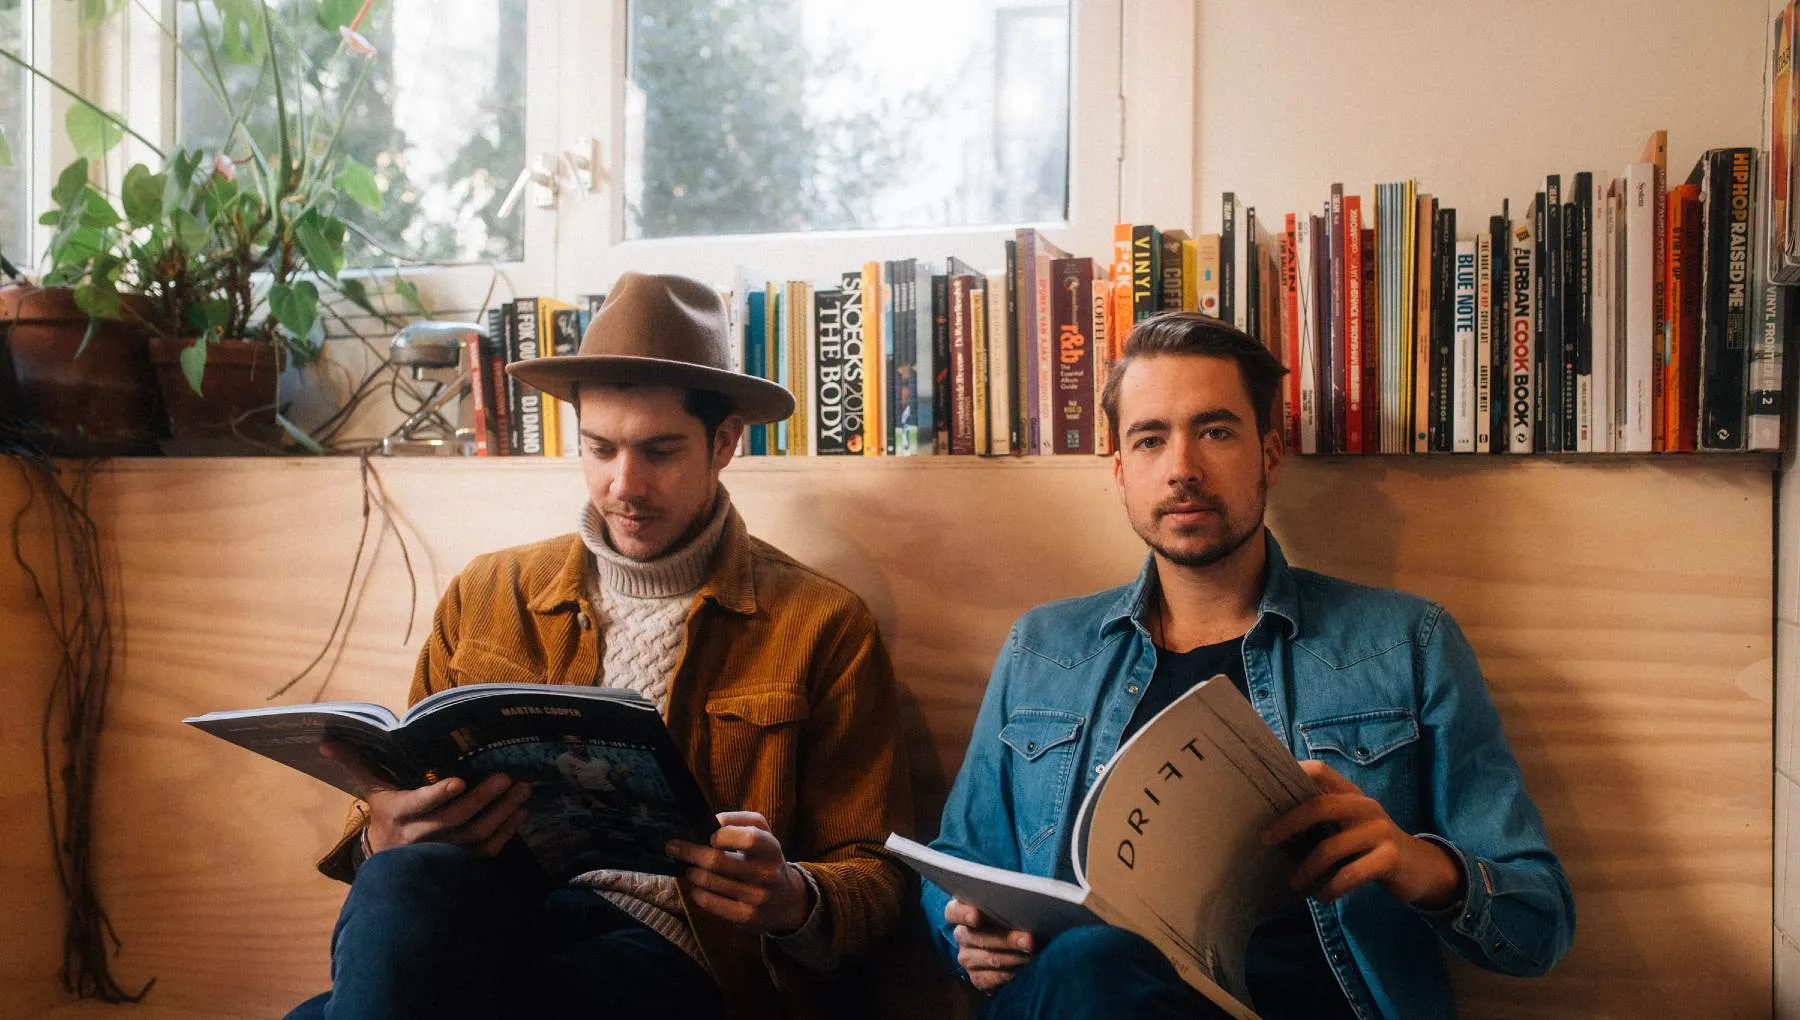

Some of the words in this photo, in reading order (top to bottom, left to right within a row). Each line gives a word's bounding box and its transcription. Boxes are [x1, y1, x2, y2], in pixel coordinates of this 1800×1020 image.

[1638, 182, 1646, 208] System
[1481, 241, 1489, 252] THE
[1672, 226, 1681, 253] STIR
[1135, 236, 1152, 303] VINYL
[1457, 254, 1473, 289] BLUE
[1481, 255, 1489, 271] BOOK
[1672, 254, 1681, 264] IT
[1481, 272, 1489, 280] OF
[1514, 256, 1530, 317] URBAN
[1672, 267, 1681, 281] UP
[1481, 283, 1489, 293] HIP
[1656, 281, 1664, 296] ED
[1728, 283, 1745, 308] ME
[1457, 294, 1473, 332] NOTE
[1481, 296, 1489, 308] HOP
[1765, 286, 1777, 321] VINYL
[518, 313, 535, 341] FOK
[842, 278, 863, 381] SNOECKS
[1095, 296, 1105, 344] COFFEE
[1481, 311, 1489, 330] COVER
[1656, 299, 1664, 336] PISKOR
[820, 301, 842, 362] THE
[1060, 324, 1085, 364] r&b
[1481, 332, 1489, 344] ART
[1514, 319, 1529, 373] COOK
[1763, 322, 1776, 377] FRONTIER
[1480, 365, 1488, 389] ANDREW
[522, 395, 539, 413] DJ
[820, 366, 842, 444] BODY
[844, 382, 863, 432] 2016
[1480, 391, 1488, 413] EMERY
[1514, 374, 1529, 428] BOOK
[1762, 397, 1772, 405] 2
[522, 414, 539, 454] DANO
[501, 706, 543, 716] MARTHA
[543, 707, 581, 717] COOPER
